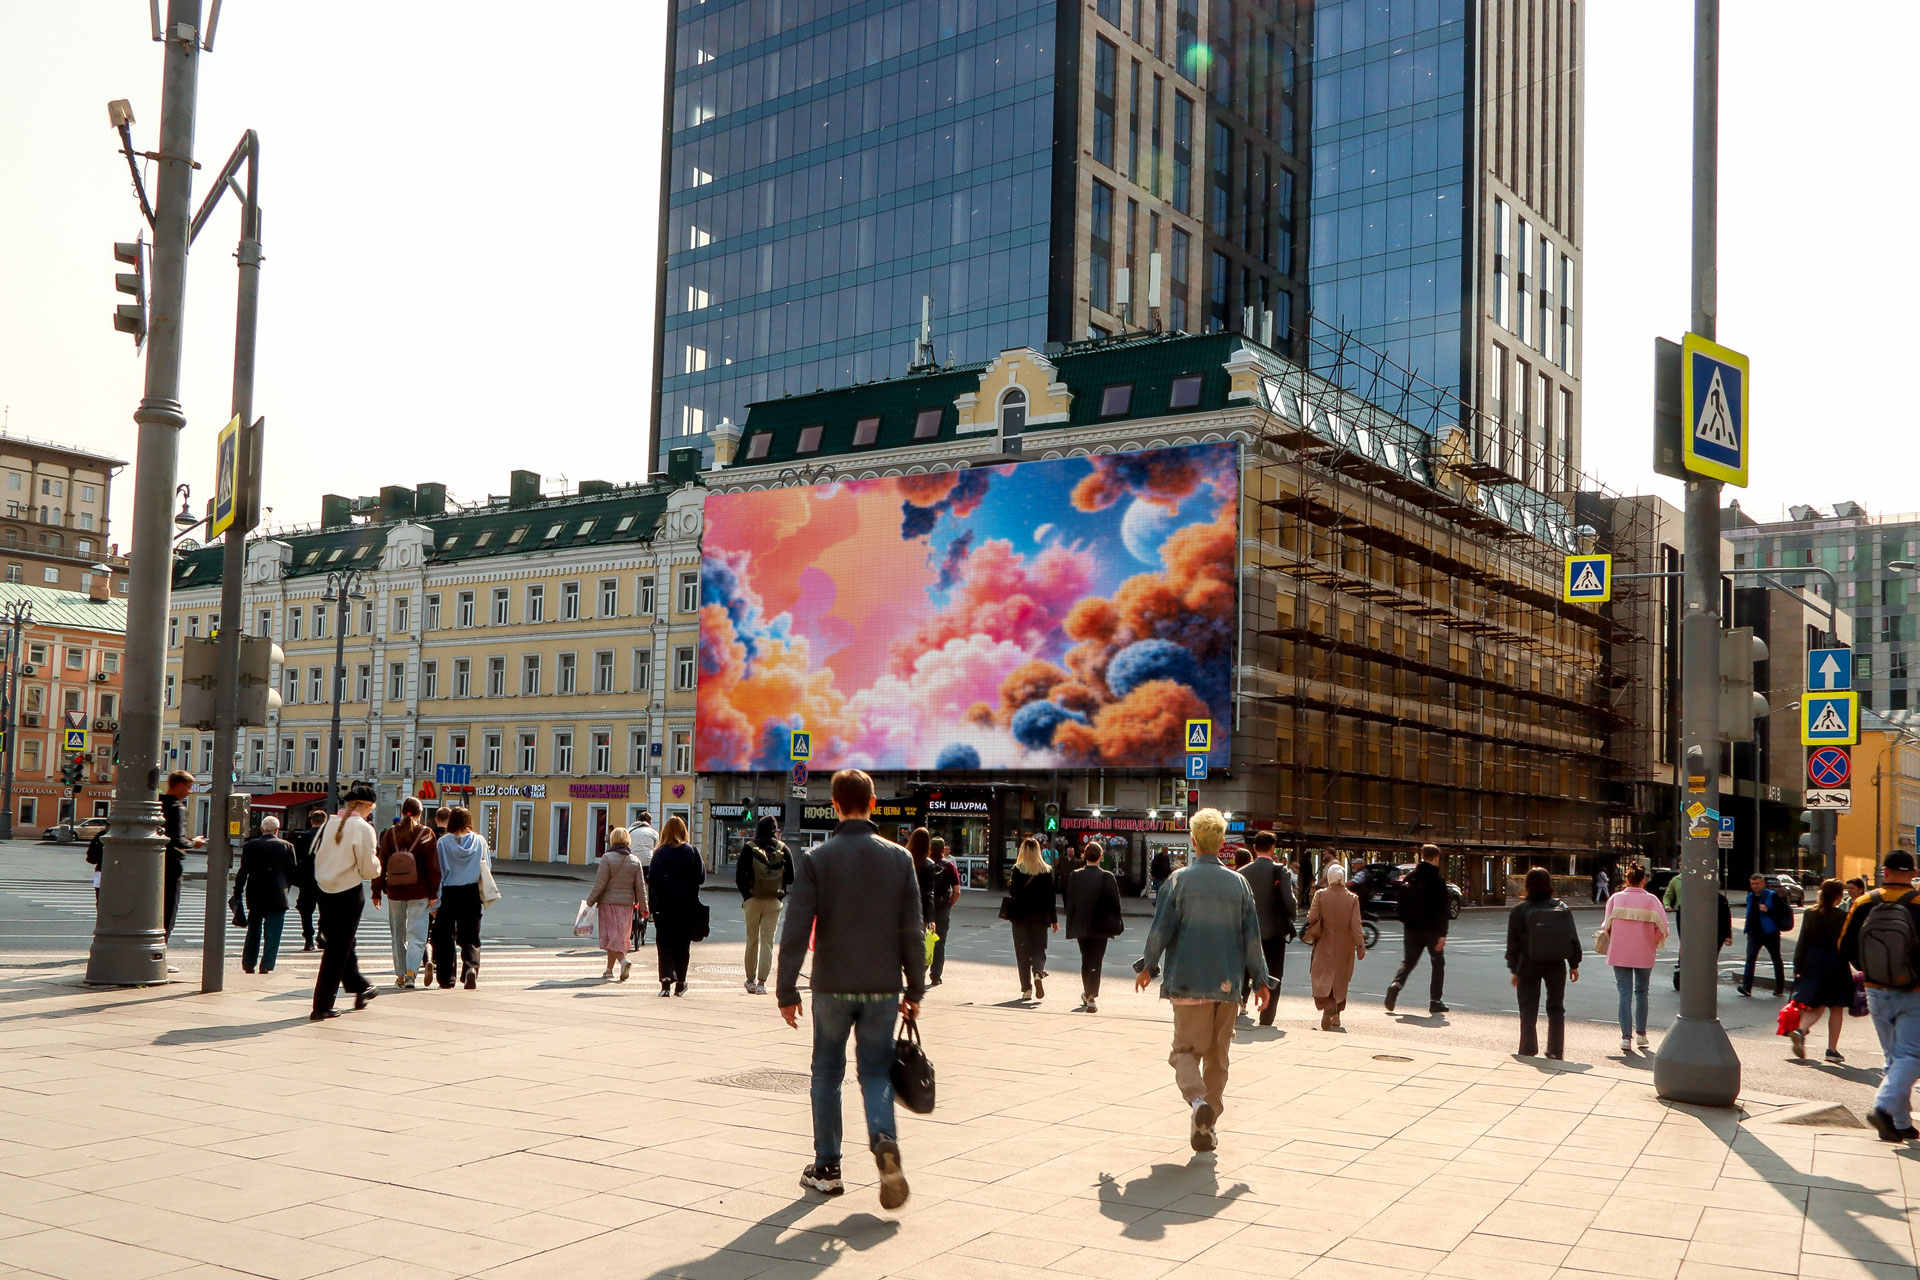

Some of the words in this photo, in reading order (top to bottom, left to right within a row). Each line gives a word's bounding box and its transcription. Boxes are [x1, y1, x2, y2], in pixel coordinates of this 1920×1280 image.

[1192, 757, 1203, 776] P
[476, 785, 496, 796] TELE2
[497, 784, 520, 796] cofix
[950, 801, 988, 810] ШАУРМА
[1722, 818, 1732, 830] P
